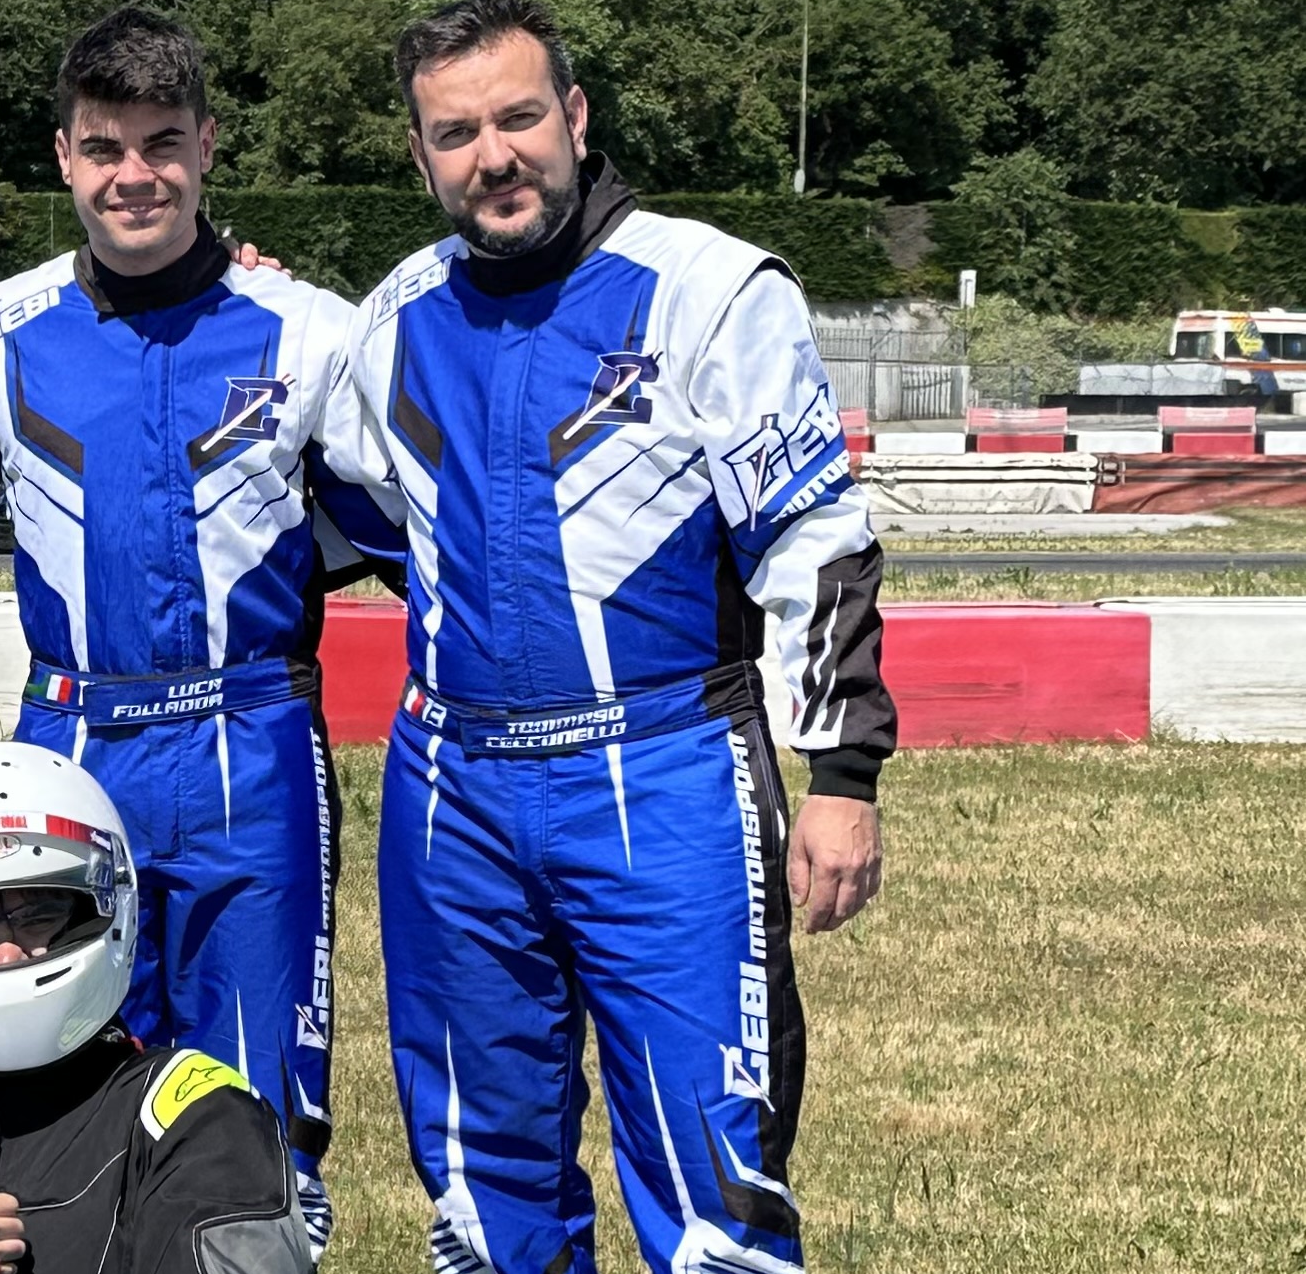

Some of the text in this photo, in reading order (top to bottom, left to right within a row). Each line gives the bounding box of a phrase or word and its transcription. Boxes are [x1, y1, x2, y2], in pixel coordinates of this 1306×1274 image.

[720, 382, 842, 532] GEB
[167, 677, 224, 700] LUCA
[506, 704, 625, 735] TOMMASO
[719, 730, 776, 1113] GEBI MOTORSPORT
